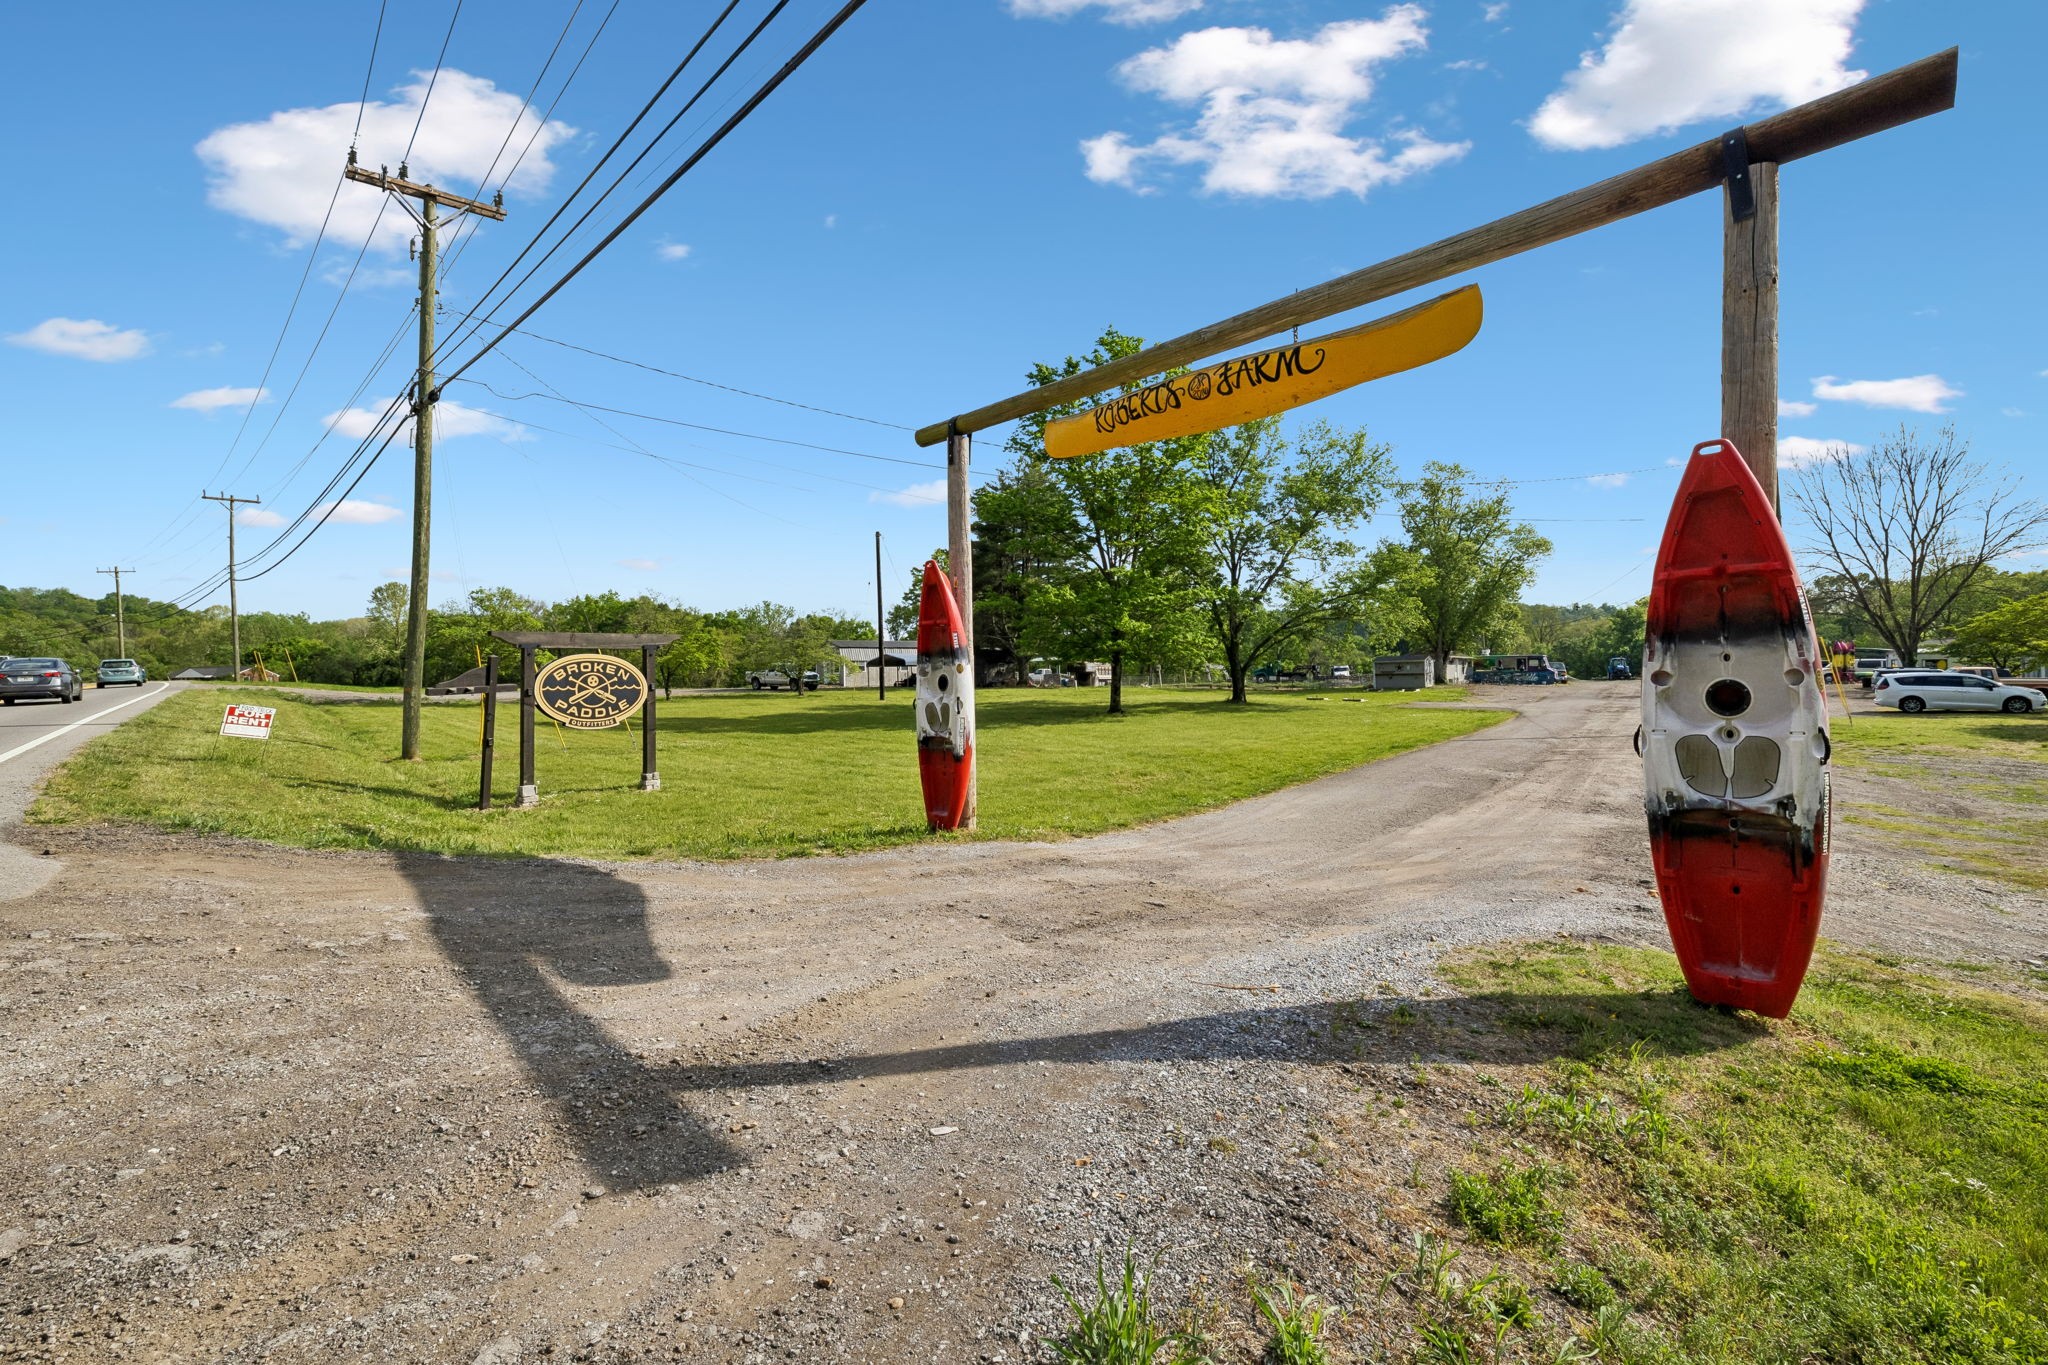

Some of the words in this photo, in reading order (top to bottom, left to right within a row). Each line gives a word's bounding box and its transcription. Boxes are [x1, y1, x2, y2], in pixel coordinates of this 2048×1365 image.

[1094, 379, 1186, 433] ROBERTS
[1213, 345, 1326, 396] FARM
[553, 662, 630, 682] BROKEN
[234, 708, 266, 719] FOR
[554, 699, 630, 718] PADDLE
[226, 715, 270, 727] RENT
[571, 720, 615, 728] OUTFITTERS
